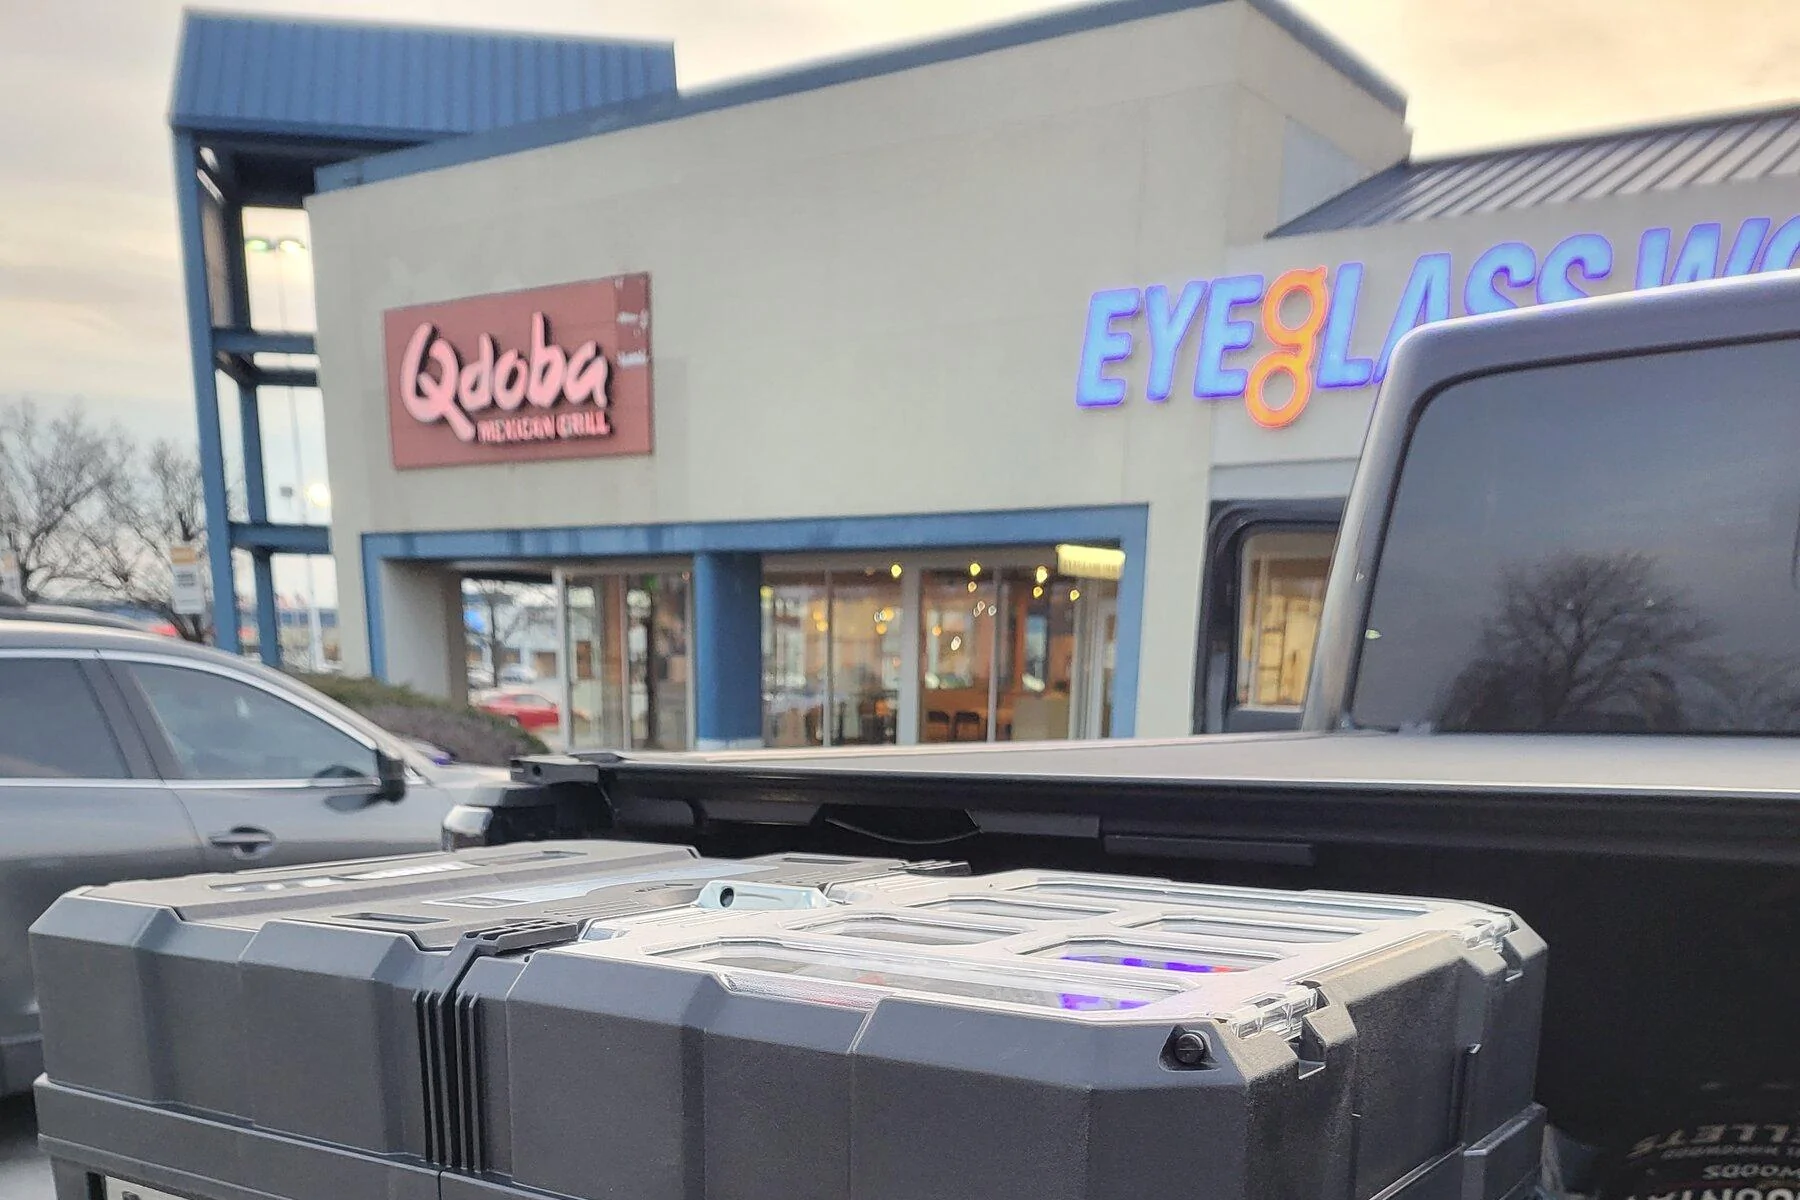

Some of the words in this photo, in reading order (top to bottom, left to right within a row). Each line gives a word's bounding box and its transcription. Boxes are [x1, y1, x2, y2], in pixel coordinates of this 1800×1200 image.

[401, 311, 609, 443] Qdoba
[477, 415, 555, 442] MEXICAN
[556, 411, 610, 438] GRILL
